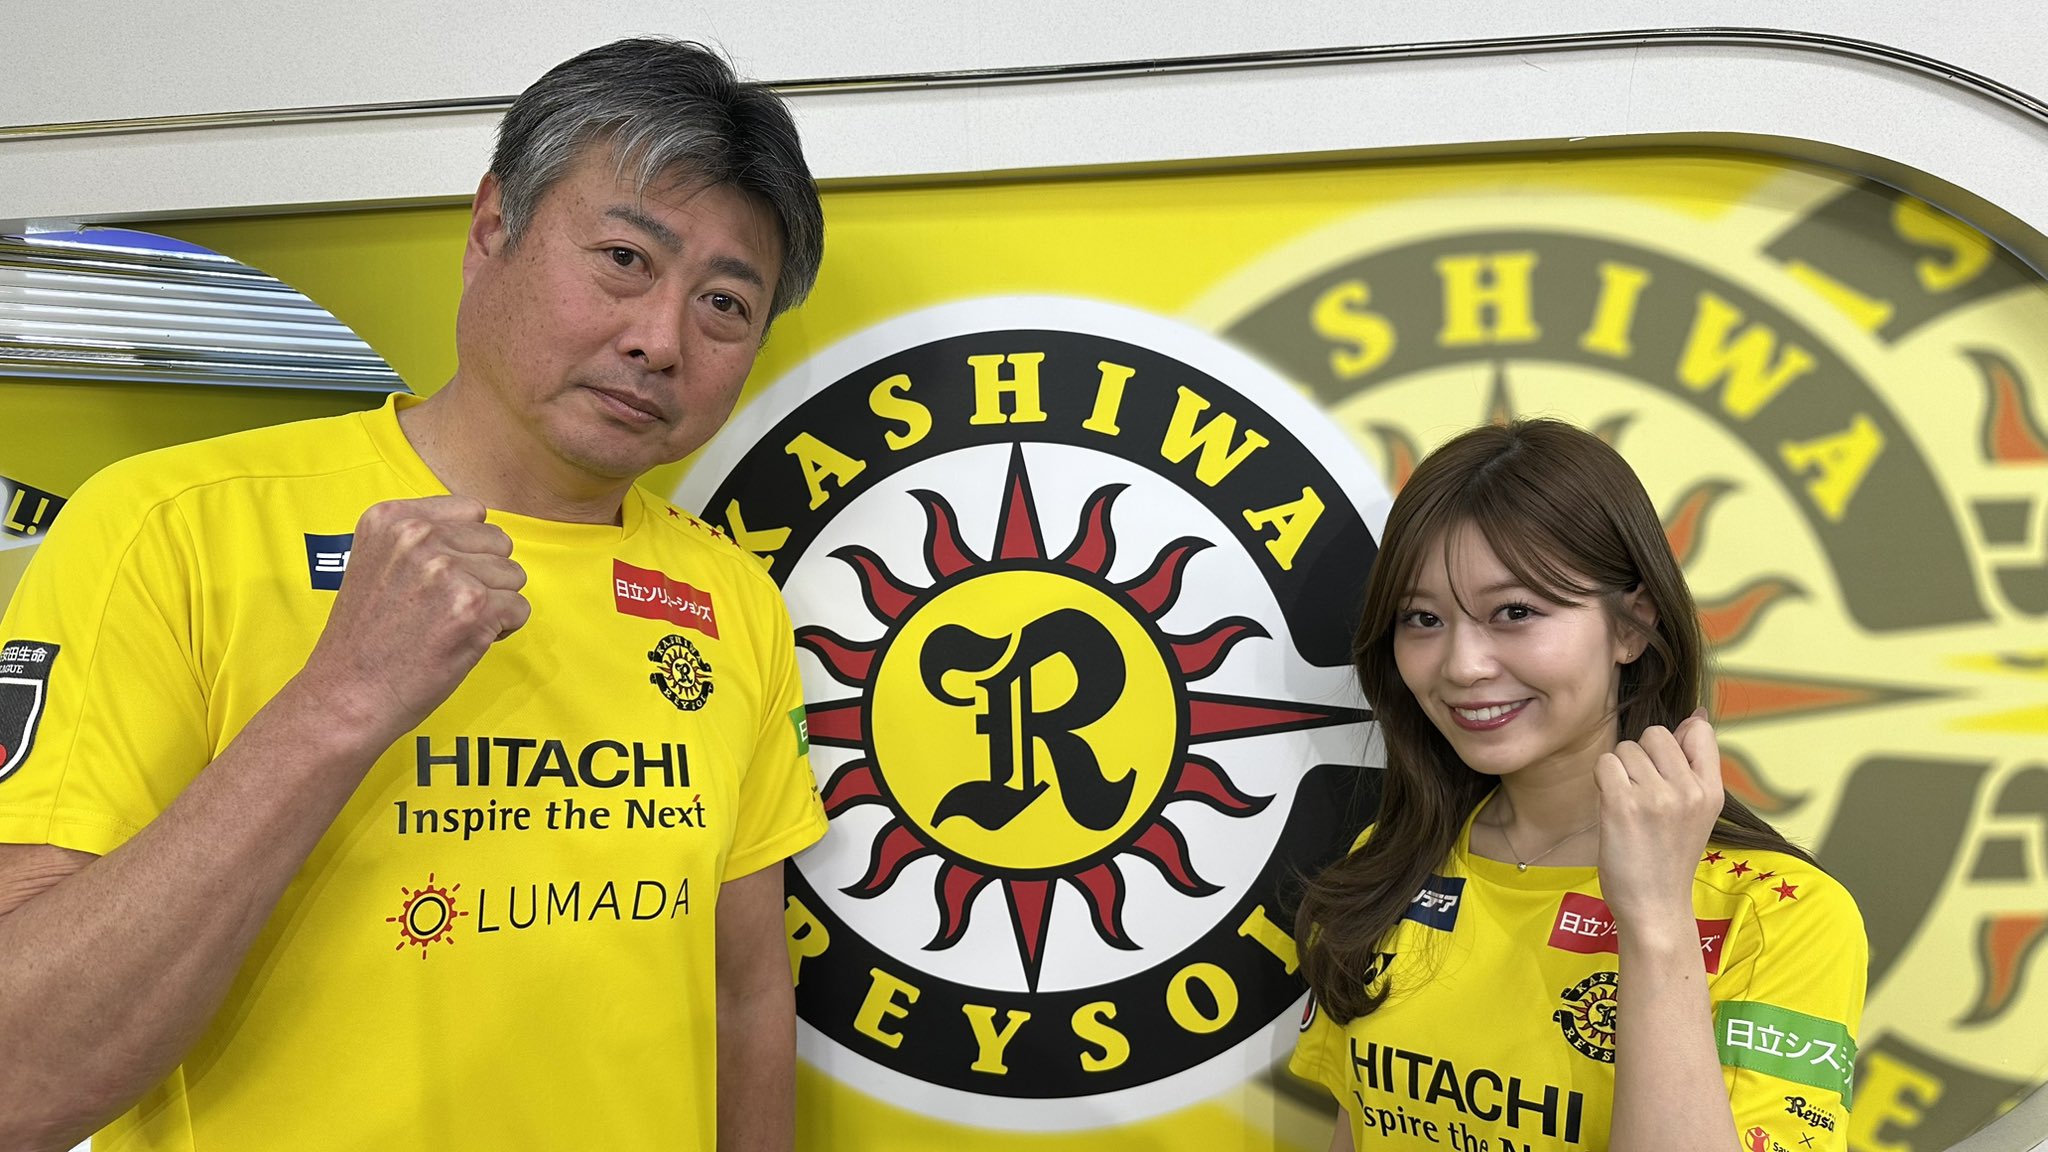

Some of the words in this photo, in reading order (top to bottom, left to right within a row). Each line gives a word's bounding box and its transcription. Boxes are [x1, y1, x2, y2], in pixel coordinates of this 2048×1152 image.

[1310, 252, 1885, 521] SHIWA
[716, 351, 1326, 573] KASHIWA
[919, 607, 1137, 831] R
[416, 736, 691, 788] HITACHI
[394, 799, 531, 841] Inspire
[546, 798, 610, 830] the
[625, 795, 706, 829] Next
[477, 878, 689, 934] LUMADA
[1559, 911, 1618, 937] 日立ソ
[1564, 1027, 1613, 1061] REYS
[1350, 1037, 1584, 1145] HITACHI
[1353, 1090, 1440, 1144] spire
